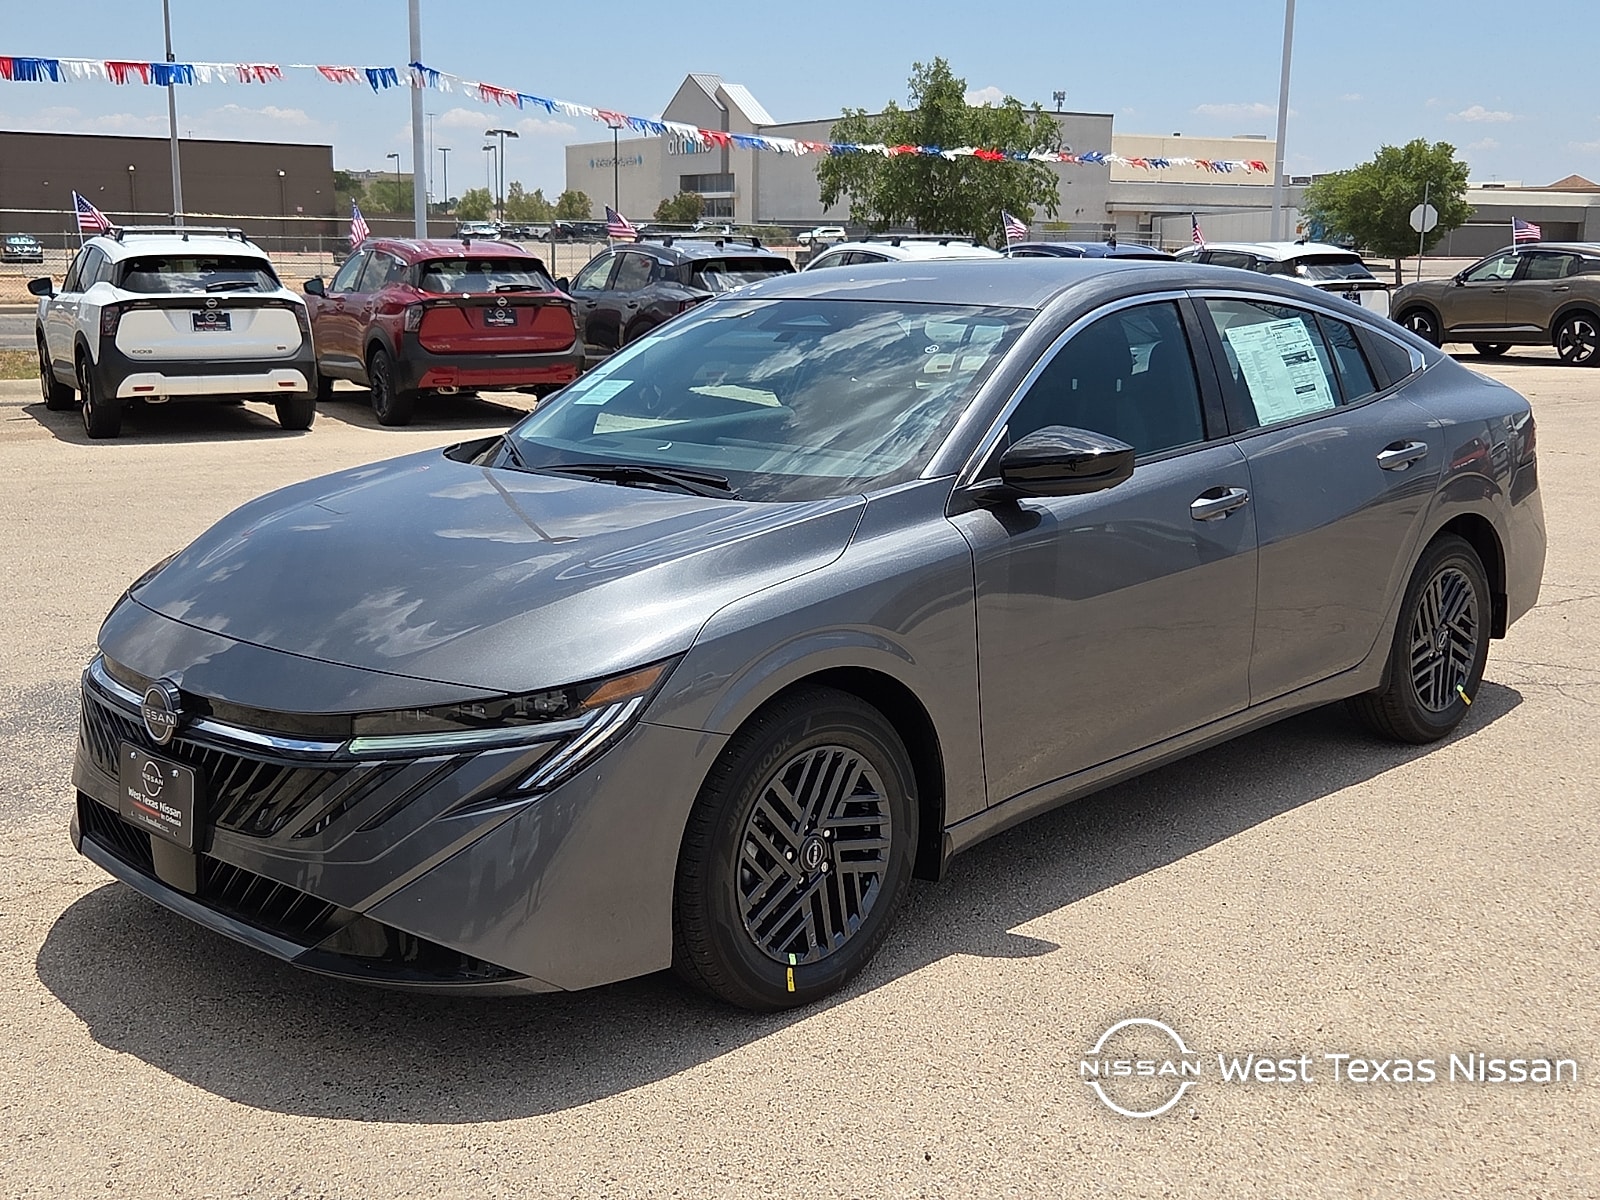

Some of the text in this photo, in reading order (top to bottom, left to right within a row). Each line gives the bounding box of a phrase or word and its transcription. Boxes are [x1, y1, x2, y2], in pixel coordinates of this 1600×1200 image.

[142, 771, 164, 786] NISSAN
[127, 786, 182, 819] West Texas Nissan
